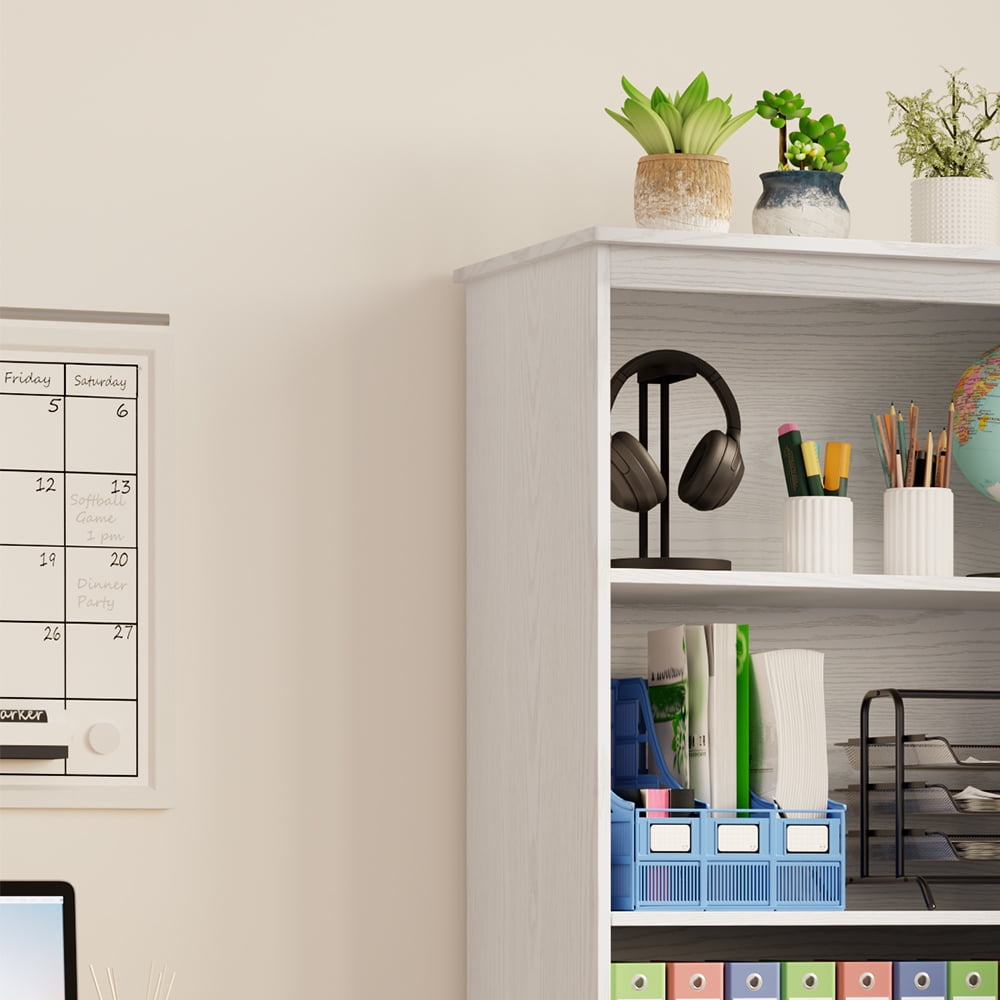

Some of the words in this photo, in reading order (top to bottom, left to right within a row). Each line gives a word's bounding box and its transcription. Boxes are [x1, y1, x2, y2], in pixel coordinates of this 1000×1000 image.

[4, 371, 51, 388] Friday
[74, 374, 127, 391] Saturday
[48, 398, 61, 413] 5
[116, 403, 128, 418] 6
[36, 477, 56, 492] 12
[111, 479, 131, 494] 13
[70, 493, 126, 508] Softball
[75, 511, 116, 524] Game
[87, 530, 96, 541] 1
[101, 532, 125, 543] pm
[40, 552, 56, 567] 19
[110, 551, 129, 567] 20
[77, 578, 128, 590] Dinner
[77, 595, 115, 611] Party
[43, 626, 61, 641] 26
[113, 624, 133, 640] 27
